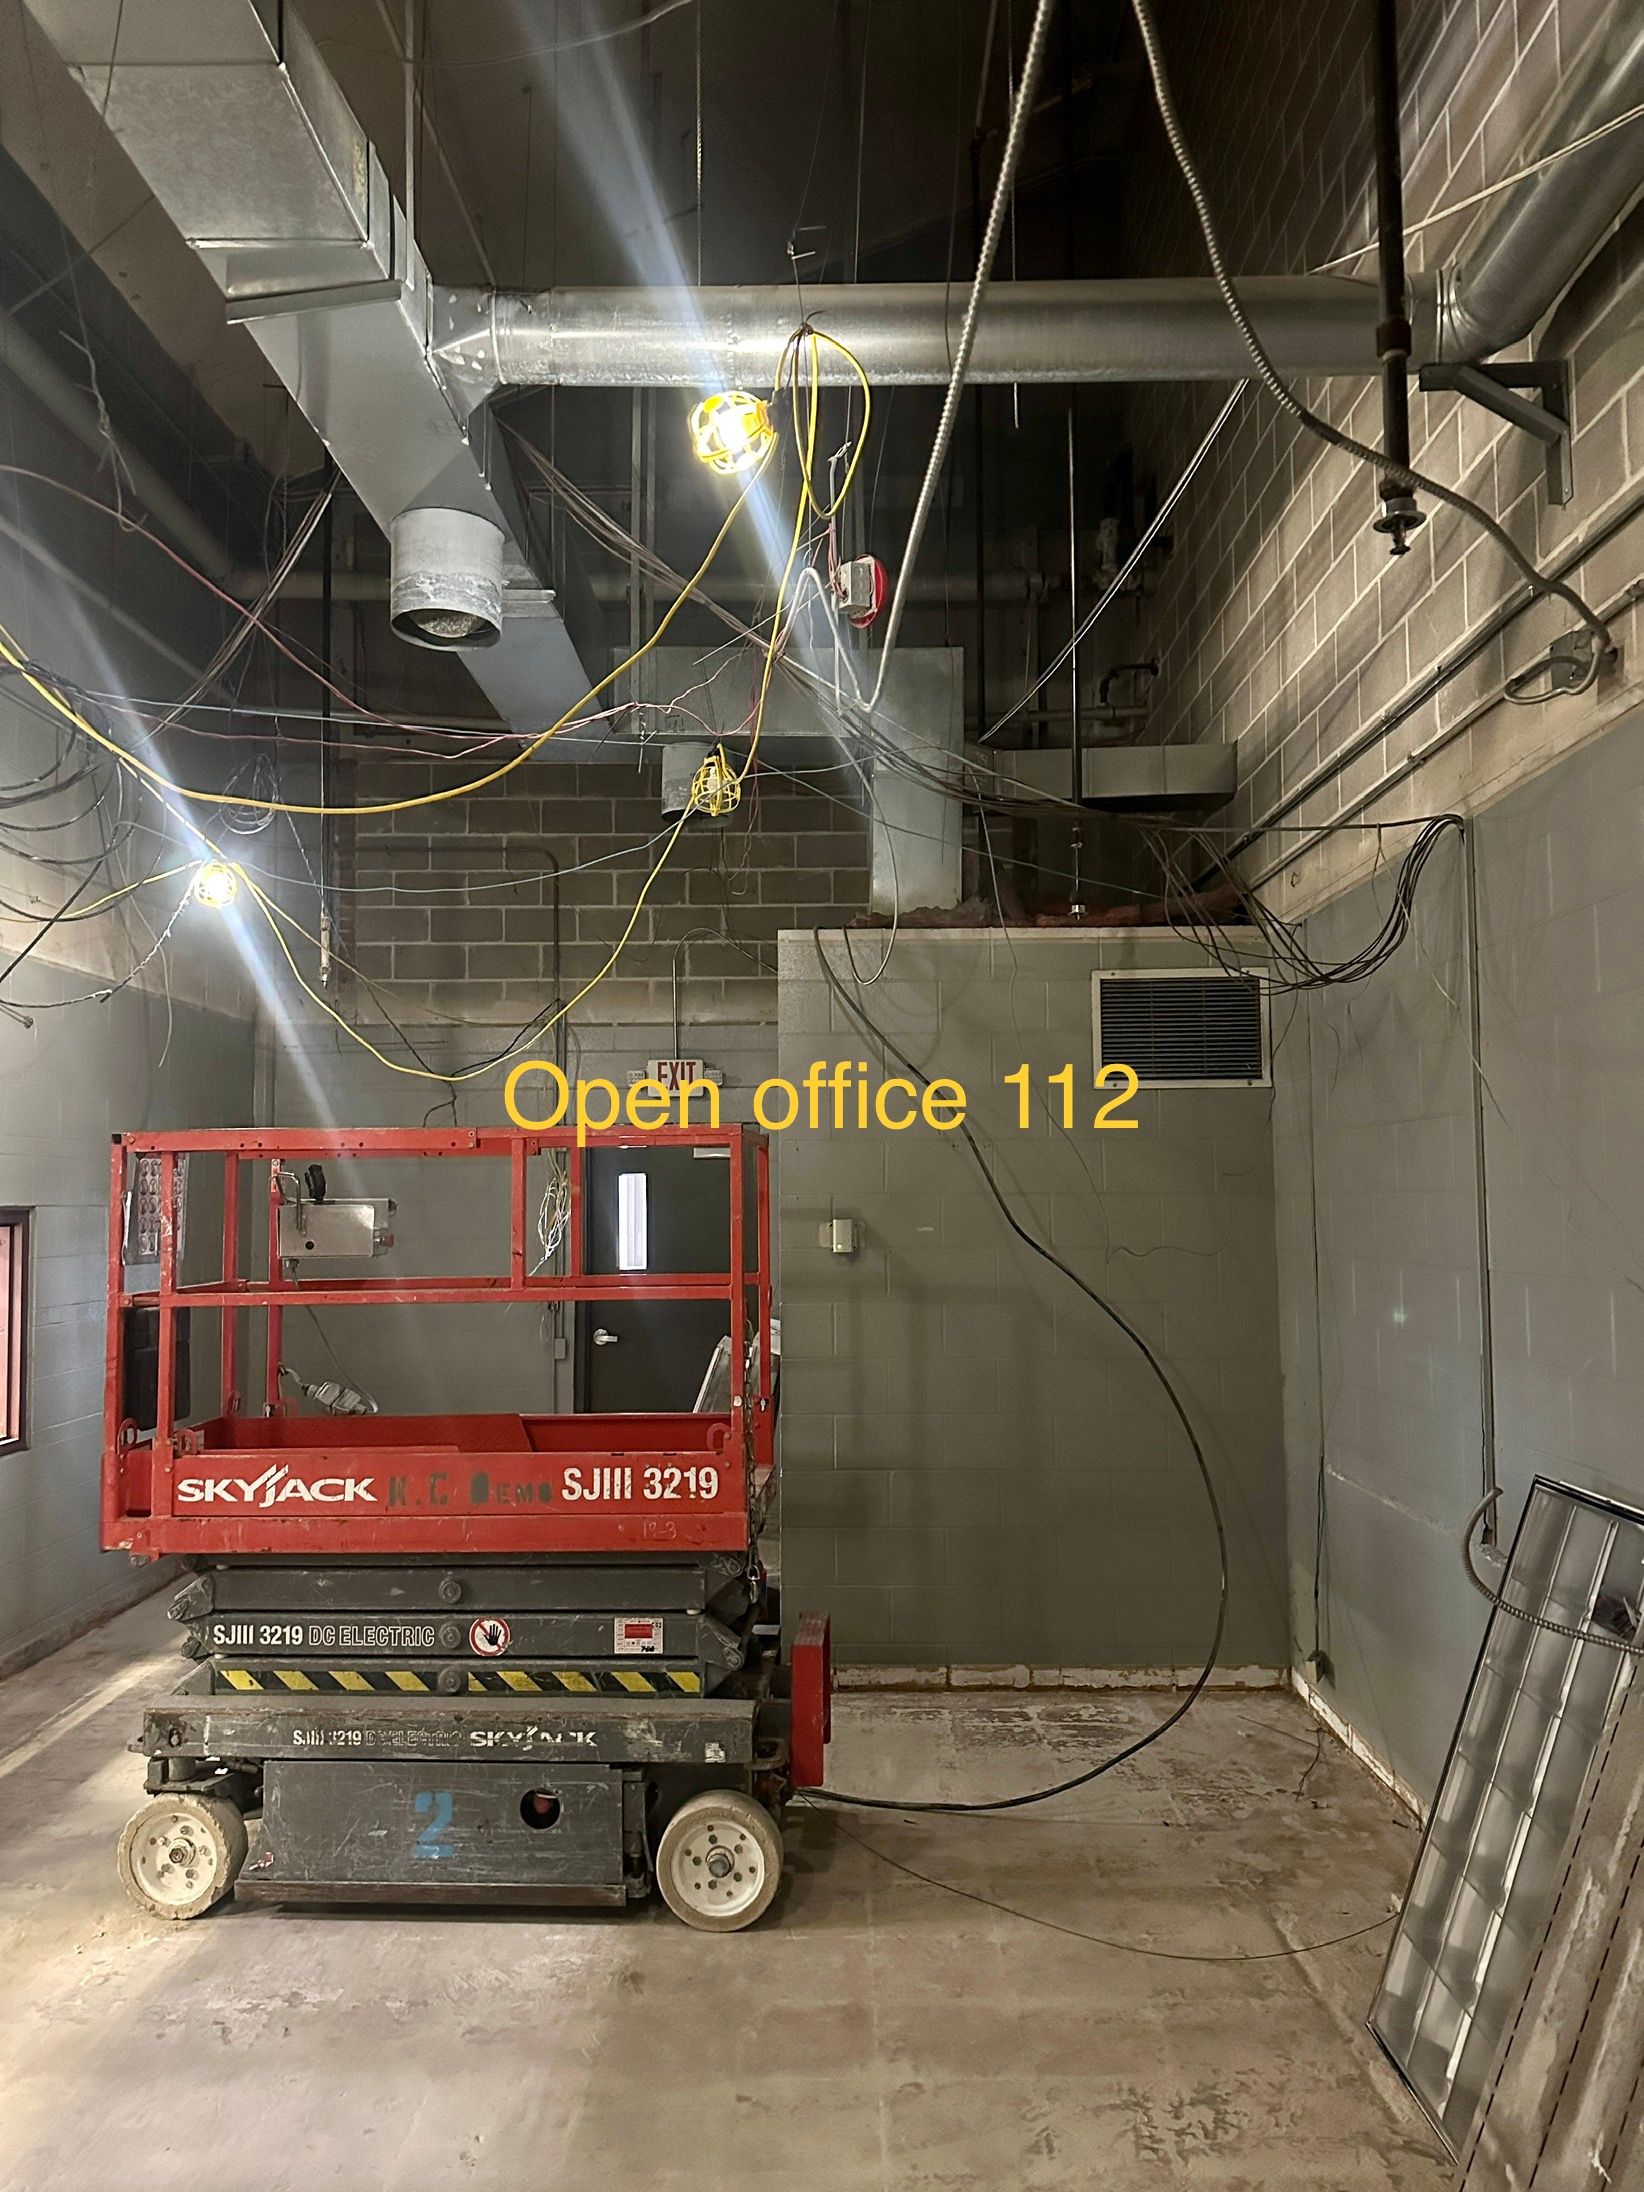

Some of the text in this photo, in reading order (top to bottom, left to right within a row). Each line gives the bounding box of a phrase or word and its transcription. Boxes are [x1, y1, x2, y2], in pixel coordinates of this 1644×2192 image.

[657, 1061, 696, 1091] EXIT
[177, 1463, 379, 1508] SKYJACK
[561, 1466, 719, 1501] SJIII 3219
[213, 1625, 435, 1647] SJIII 3219 DC ELECTRIC
[414, 1791, 454, 1858] 2
